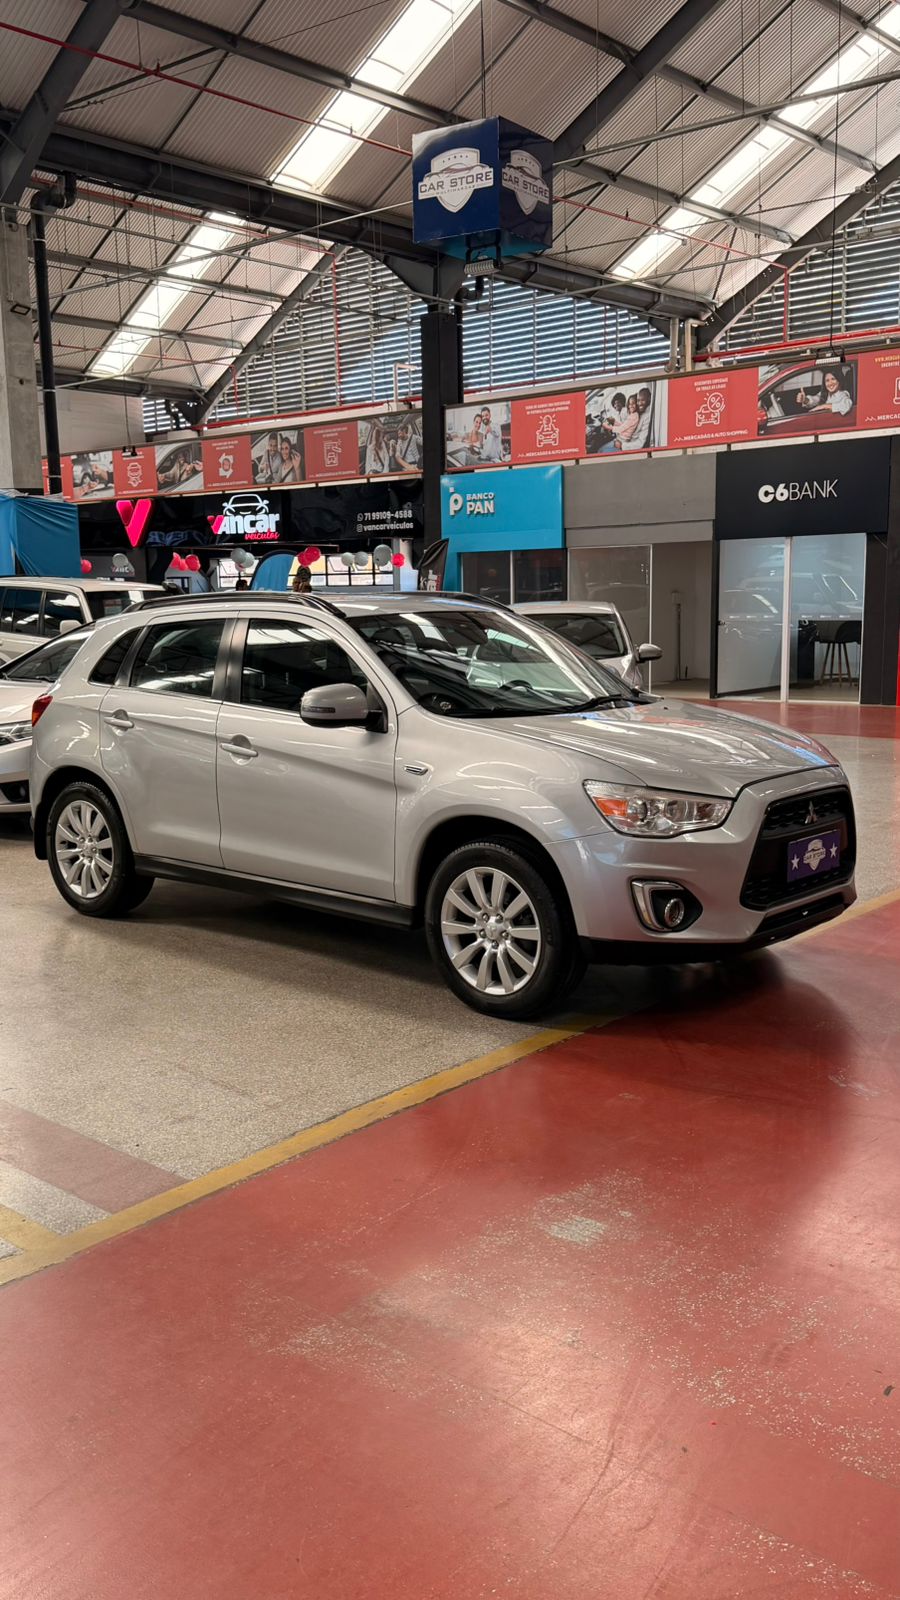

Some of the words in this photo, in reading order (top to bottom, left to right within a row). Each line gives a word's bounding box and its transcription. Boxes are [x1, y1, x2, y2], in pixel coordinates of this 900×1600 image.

[419, 181, 444, 194] CAR
[449, 170, 492, 188] STORE
[502, 171, 520, 187] CAR
[522, 180, 549, 199] STORE
[466, 492, 495, 501] BANCO
[466, 500, 495, 514] PAN
[364, 512, 371, 520] 71
